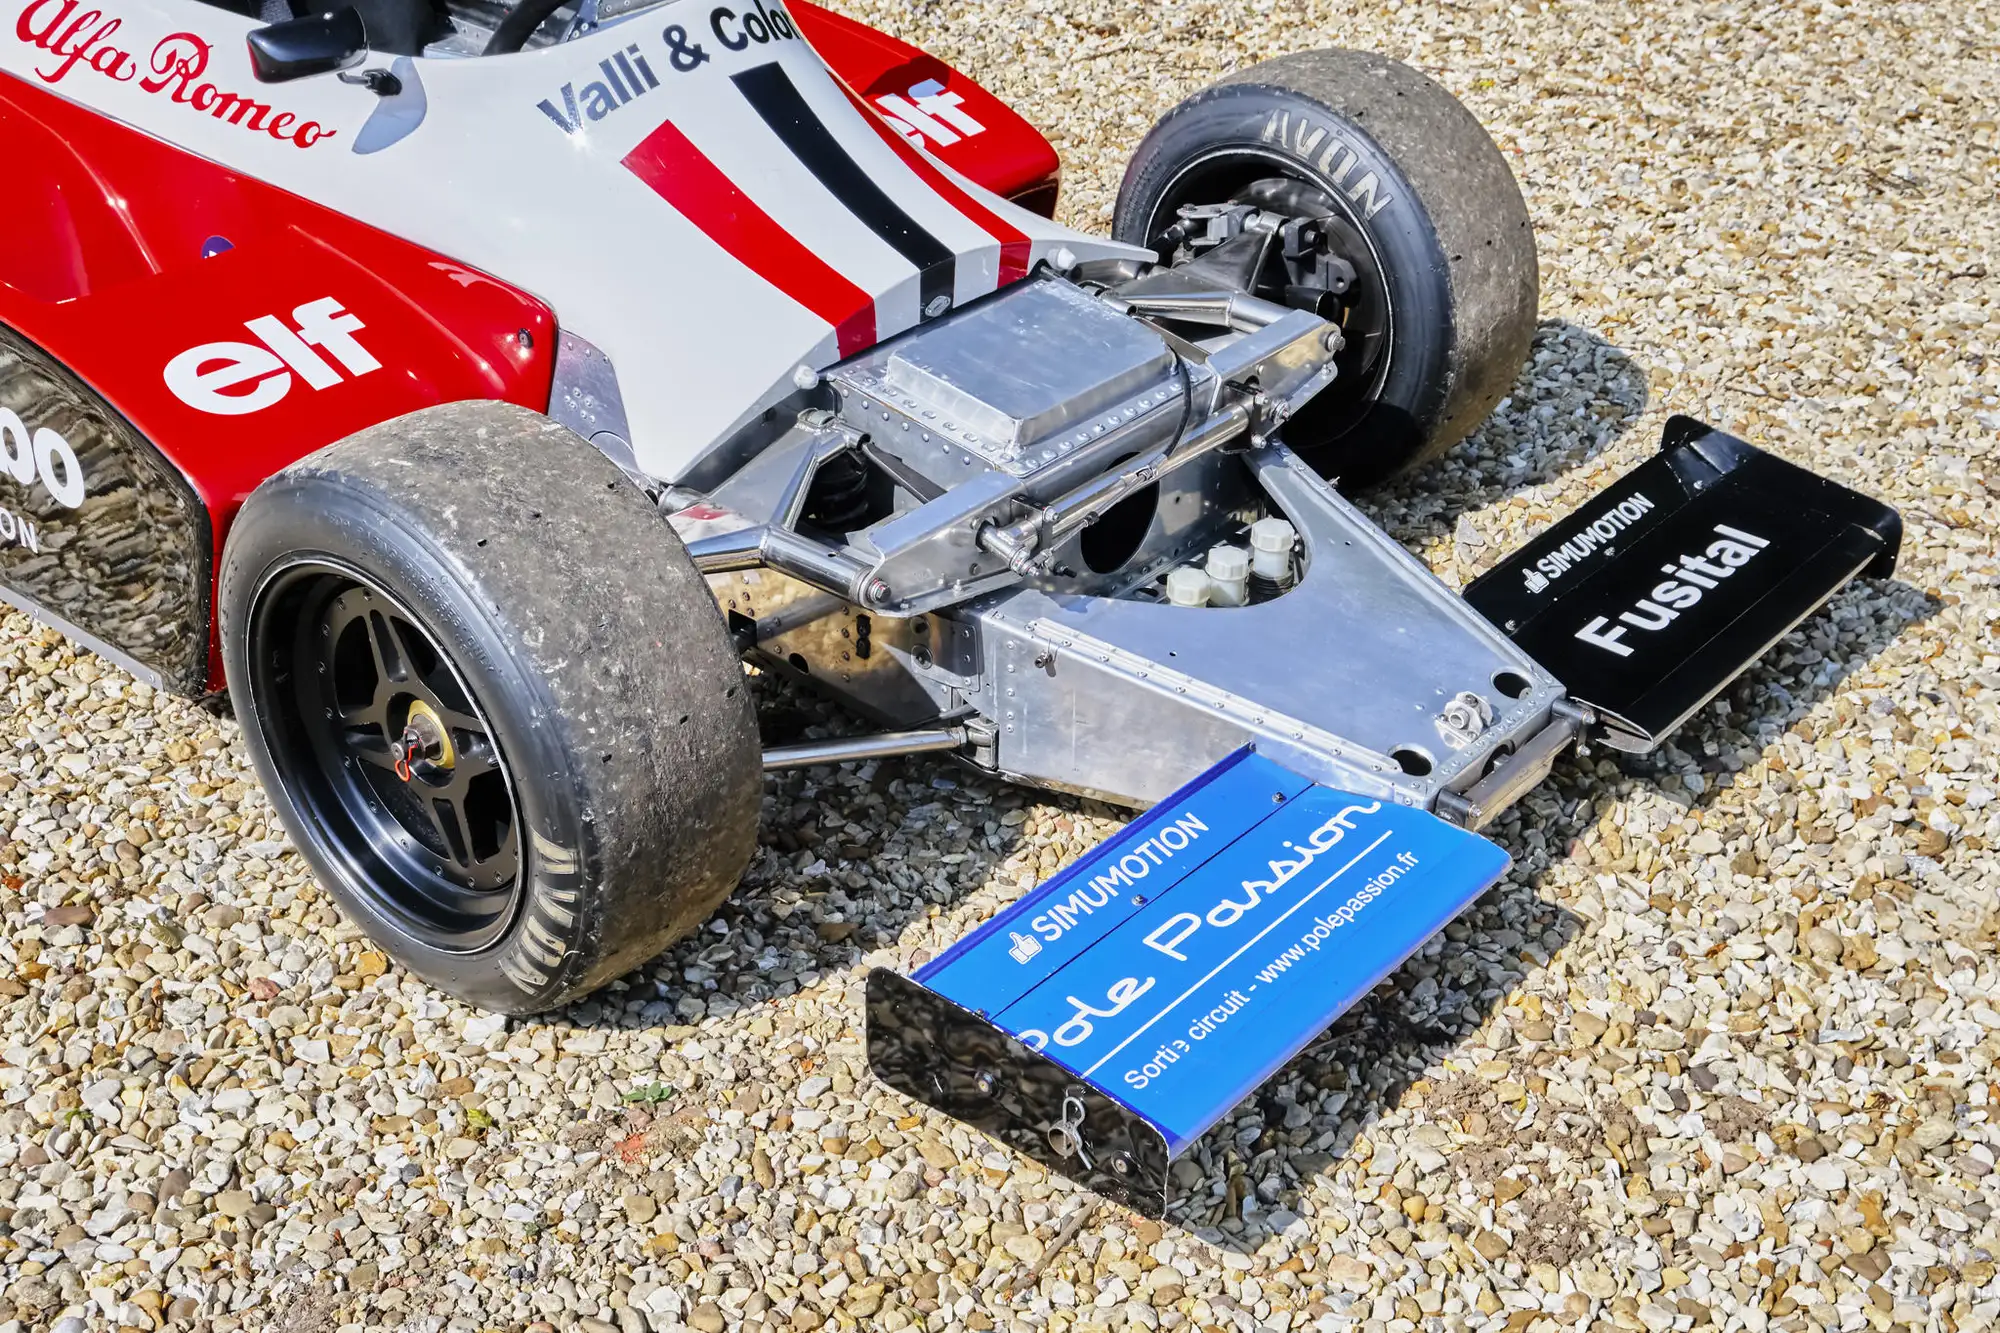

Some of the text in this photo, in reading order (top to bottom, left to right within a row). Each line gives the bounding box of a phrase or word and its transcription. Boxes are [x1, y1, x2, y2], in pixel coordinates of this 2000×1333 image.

[16, 0, 336, 148] Alfa Romeo
[537, 0, 801, 136] Valli & Colo
[1261, 108, 1394, 220] AVON
[163, 296, 383, 415] elf
[0, 407, 85, 509] 00
[1537, 492, 1655, 579] SIMUMOTION
[1574, 524, 1771, 657] Fusital
[498, 825, 579, 997] AVON
[1031, 811, 1209, 941] SIMUMOTION
[1142, 801, 1382, 961] Passion
[1188, 988, 1251, 1041] circuit
[1255, 849, 1420, 984] www.polepassion.fr
